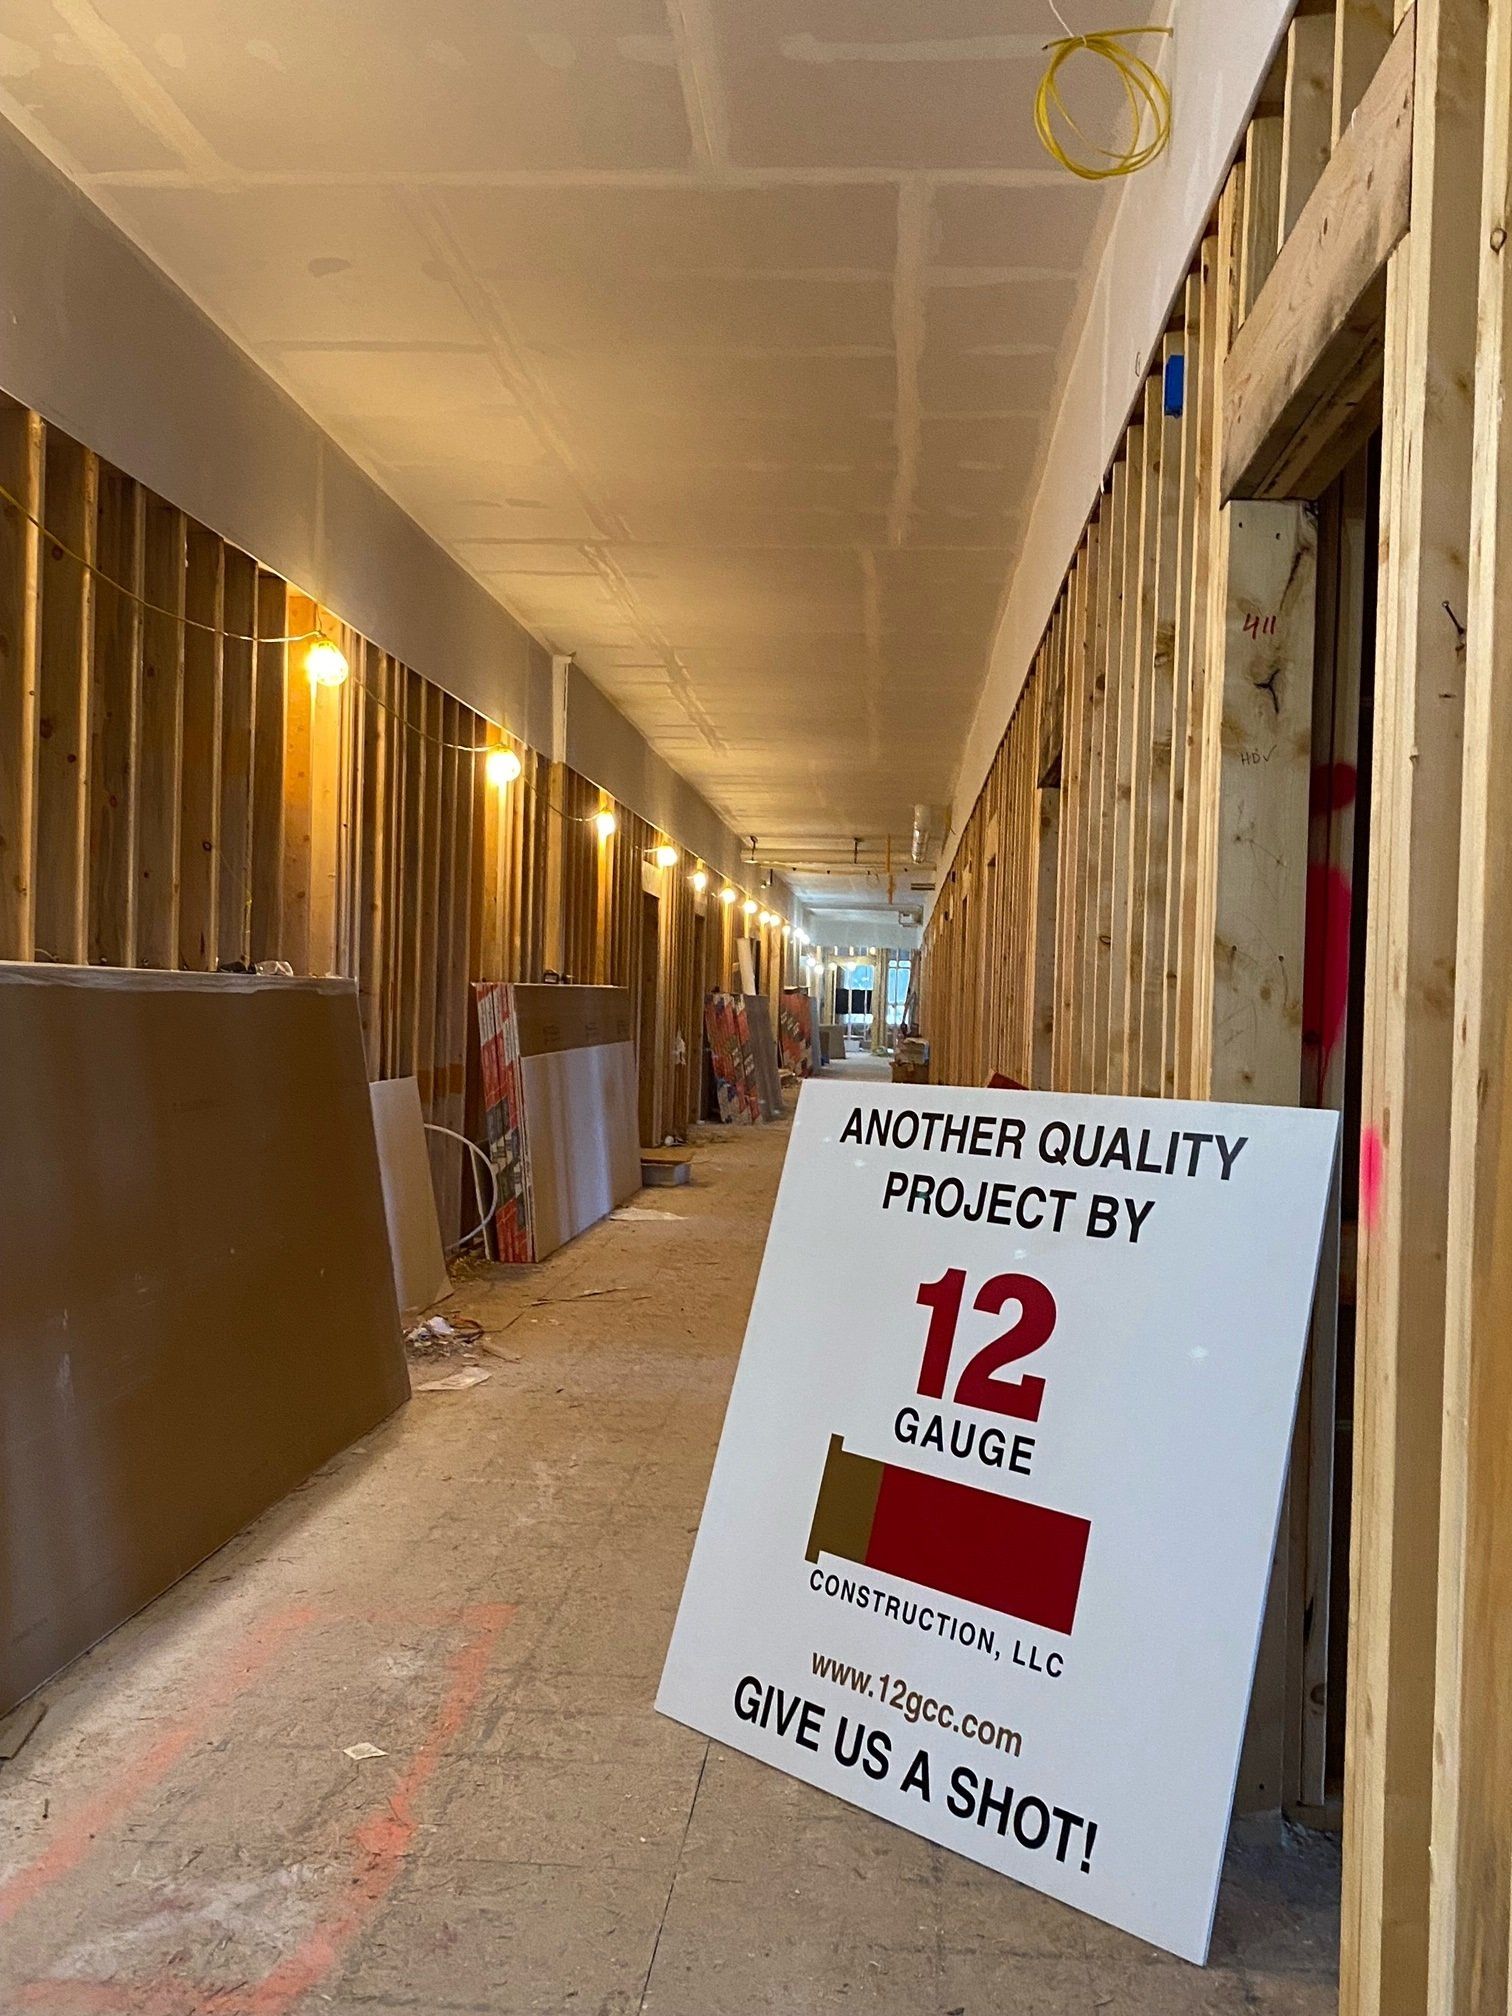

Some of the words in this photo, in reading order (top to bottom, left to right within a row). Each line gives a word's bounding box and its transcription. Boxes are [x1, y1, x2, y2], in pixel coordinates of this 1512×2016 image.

[839, 1107, 1027, 1160] ANOTHER
[1038, 1120, 1249, 1181] QUALITY
[882, 1171, 1078, 1233] PROJECT
[1085, 1193, 1156, 1244] BY
[915, 1267, 1057, 1423] 12
[894, 1406, 1036, 1476] GAUGE
[809, 1568, 1001, 1662] CONSTRUCTION,
[1012, 1639, 1065, 1679] LLC
[812, 1652, 1023, 1758] www.12gcc.com
[734, 1675, 826, 1753] GIVE
[834, 1715, 892, 1781] US
[899, 1749, 931, 1803] A
[946, 1766, 1098, 1875] SHOT!
